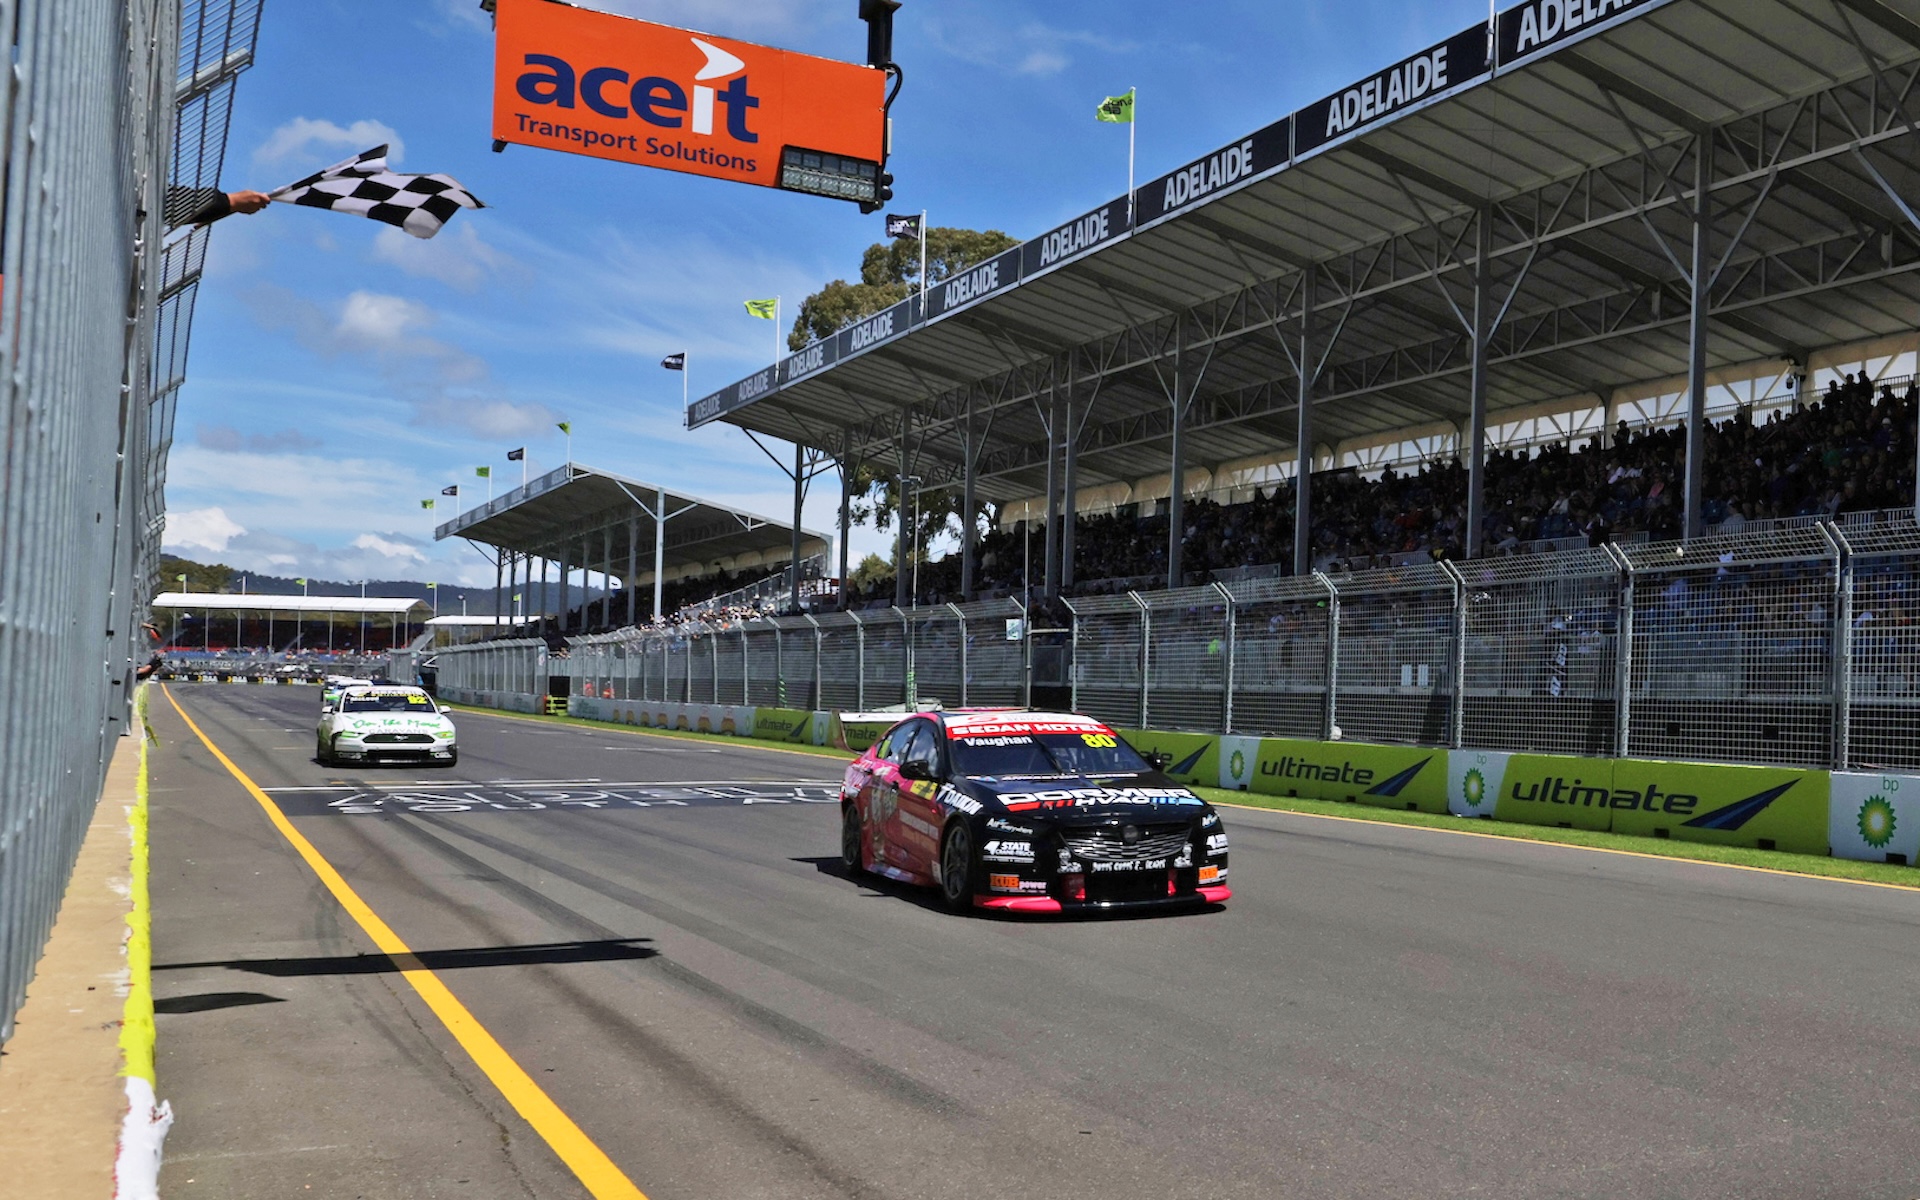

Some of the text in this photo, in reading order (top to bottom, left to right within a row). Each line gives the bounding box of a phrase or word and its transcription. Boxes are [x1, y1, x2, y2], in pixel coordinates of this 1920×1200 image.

[516, 45, 759, 143] aceit
[1325, 45, 1448, 137] ADELAIDE
[514, 113, 757, 172] Transport Solutions
[1163, 142, 1253, 210] ADELAIDE
[1041, 208, 1109, 267] ADELAIDE
[944, 260, 999, 310] ADELAIDE
[851, 310, 894, 352] ADELAIDE
[788, 345, 823, 379] ADELAIDE
[738, 371, 769, 401] ADELAIDE
[756, 717, 793, 731] ultimate
[952, 723, 1108, 735] SEDAN HOTEL
[963, 736, 1033, 747] Vaughan
[1080, 733, 1118, 748] 80
[1261, 756, 1374, 785] ultimate
[1476, 753, 1487, 766] bp
[997, 788, 1196, 806] DORMER
[1512, 777, 1698, 815] ultimate
[1882, 776, 1899, 794] bp
[944, 789, 984, 815] DAIKIN
[1001, 841, 1031, 851] STATE
